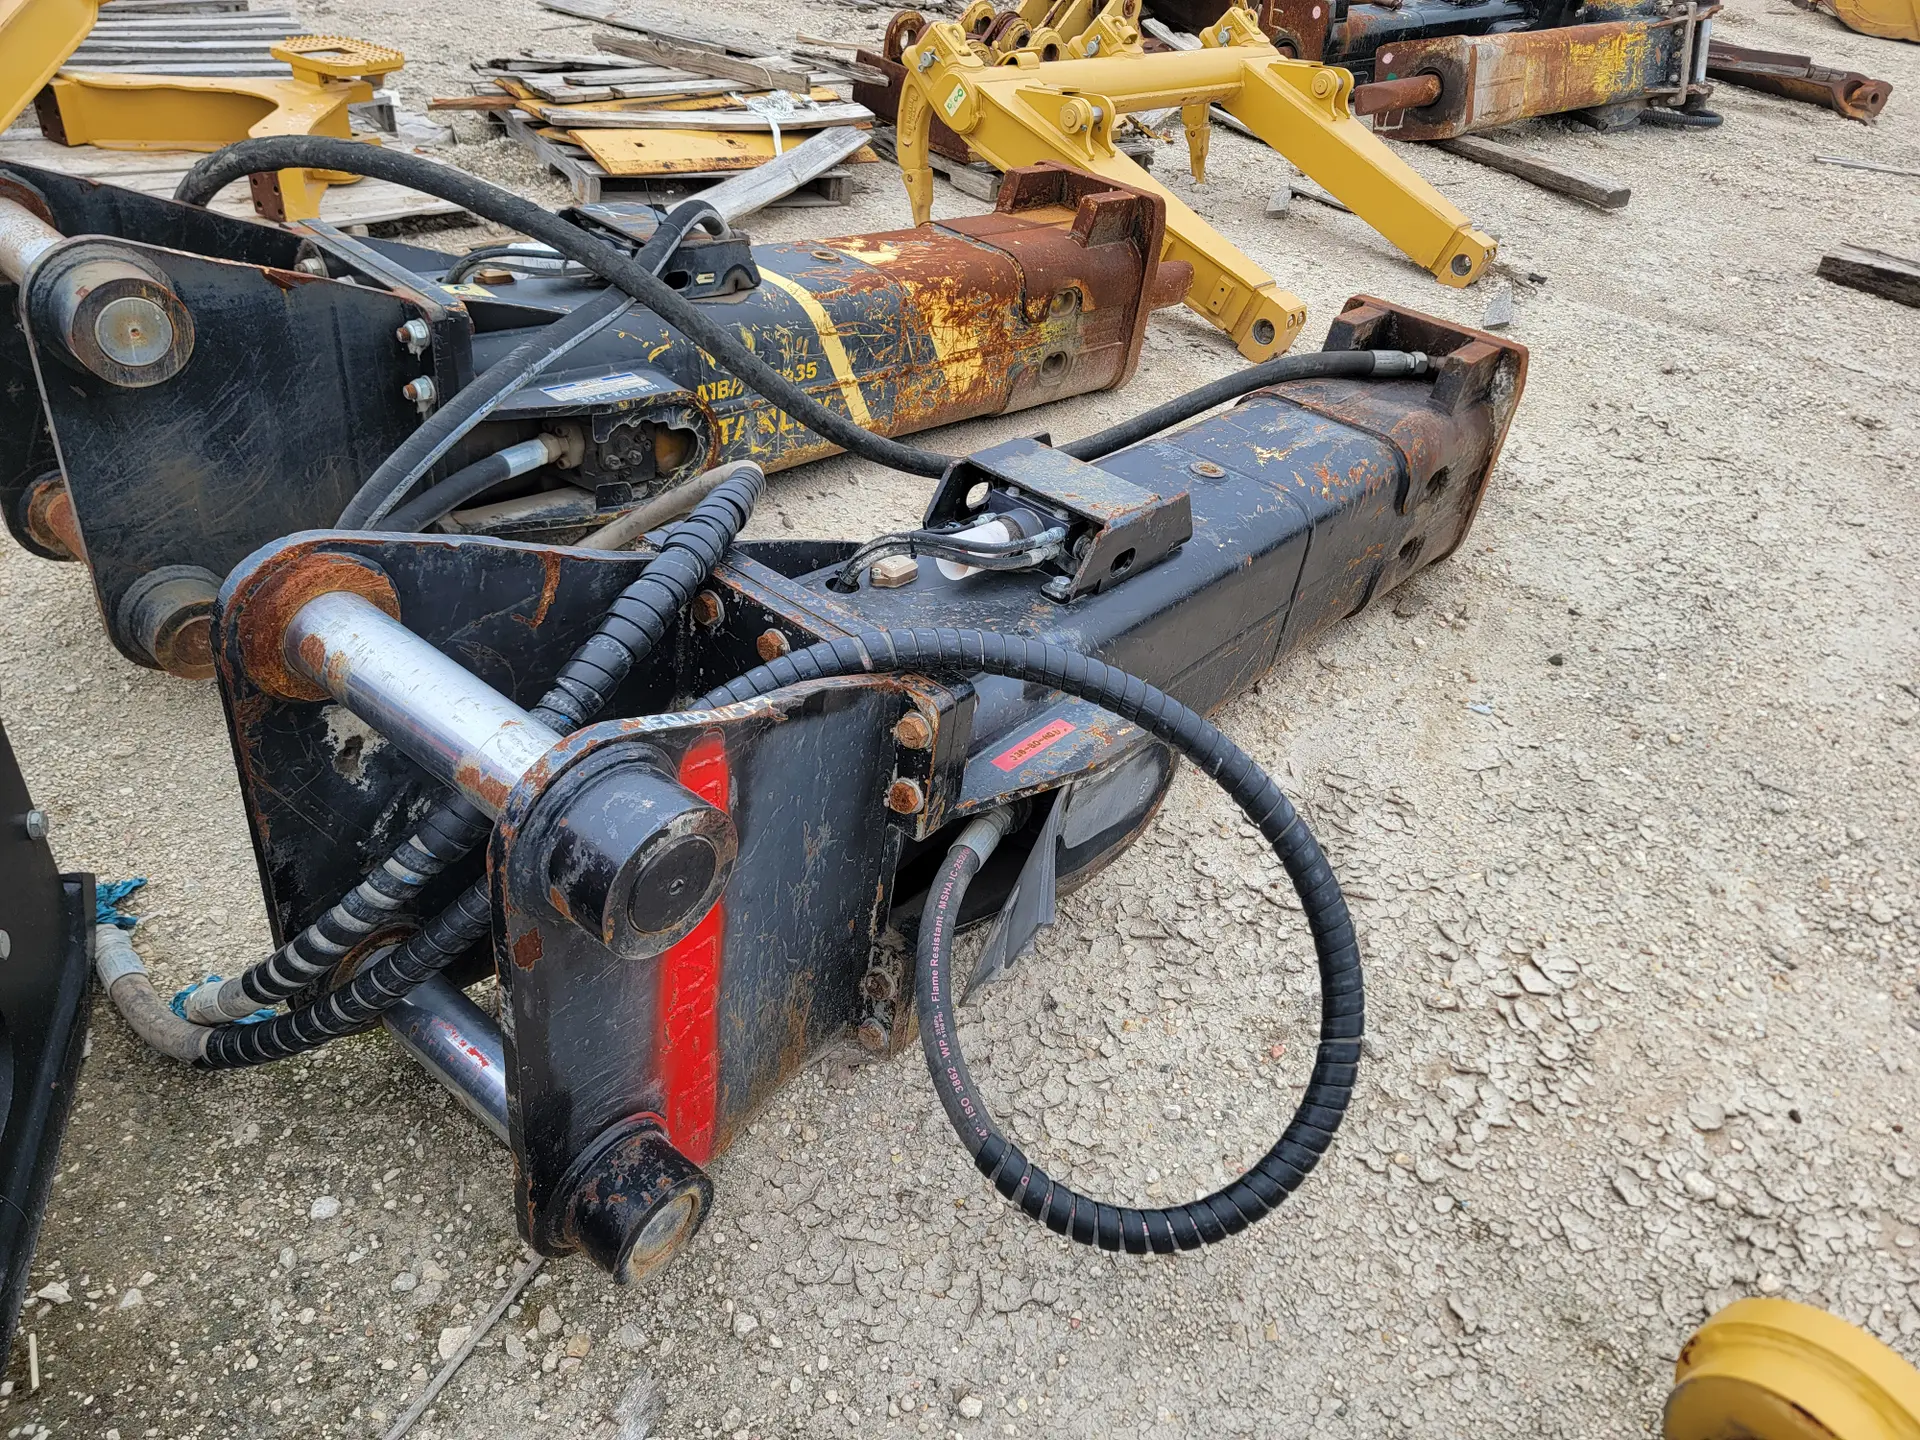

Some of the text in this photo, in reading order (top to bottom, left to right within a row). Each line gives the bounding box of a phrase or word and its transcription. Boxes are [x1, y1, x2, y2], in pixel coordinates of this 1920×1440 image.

[938, 881, 954, 910] MSHA
[930, 915, 944, 967] Resistant
[931, 971, 940, 1002] Flame
[939, 1039, 951, 1058] WP
[947, 1066, 964, 1094] 3862
[960, 1097, 976, 1119] ISO
